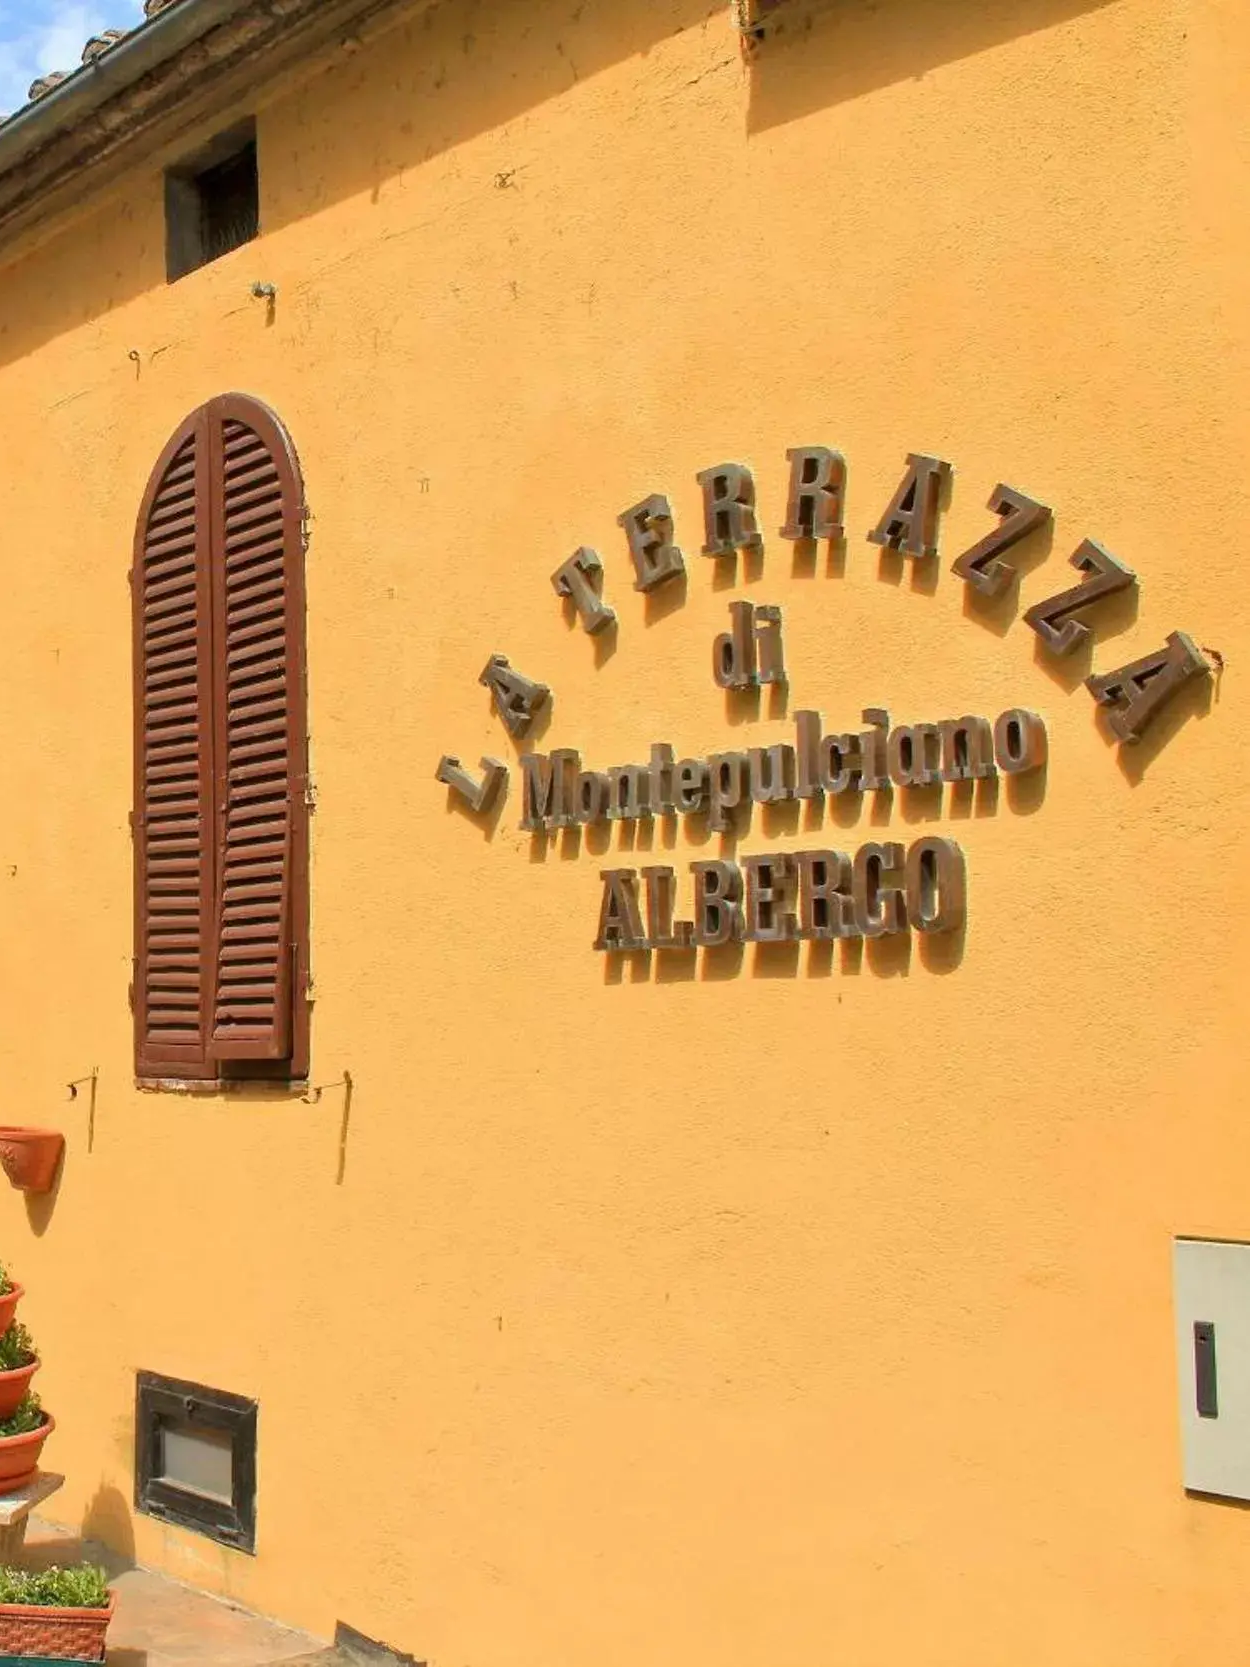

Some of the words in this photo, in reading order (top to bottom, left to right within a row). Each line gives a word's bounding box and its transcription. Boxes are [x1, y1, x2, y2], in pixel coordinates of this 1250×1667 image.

[435, 654, 552, 814] LA
[550, 445, 1212, 747] TERRAZZA
[713, 600, 786, 692] di
[518, 708, 1047, 834] Montepulciano
[593, 835, 967, 951] ALBERGO
